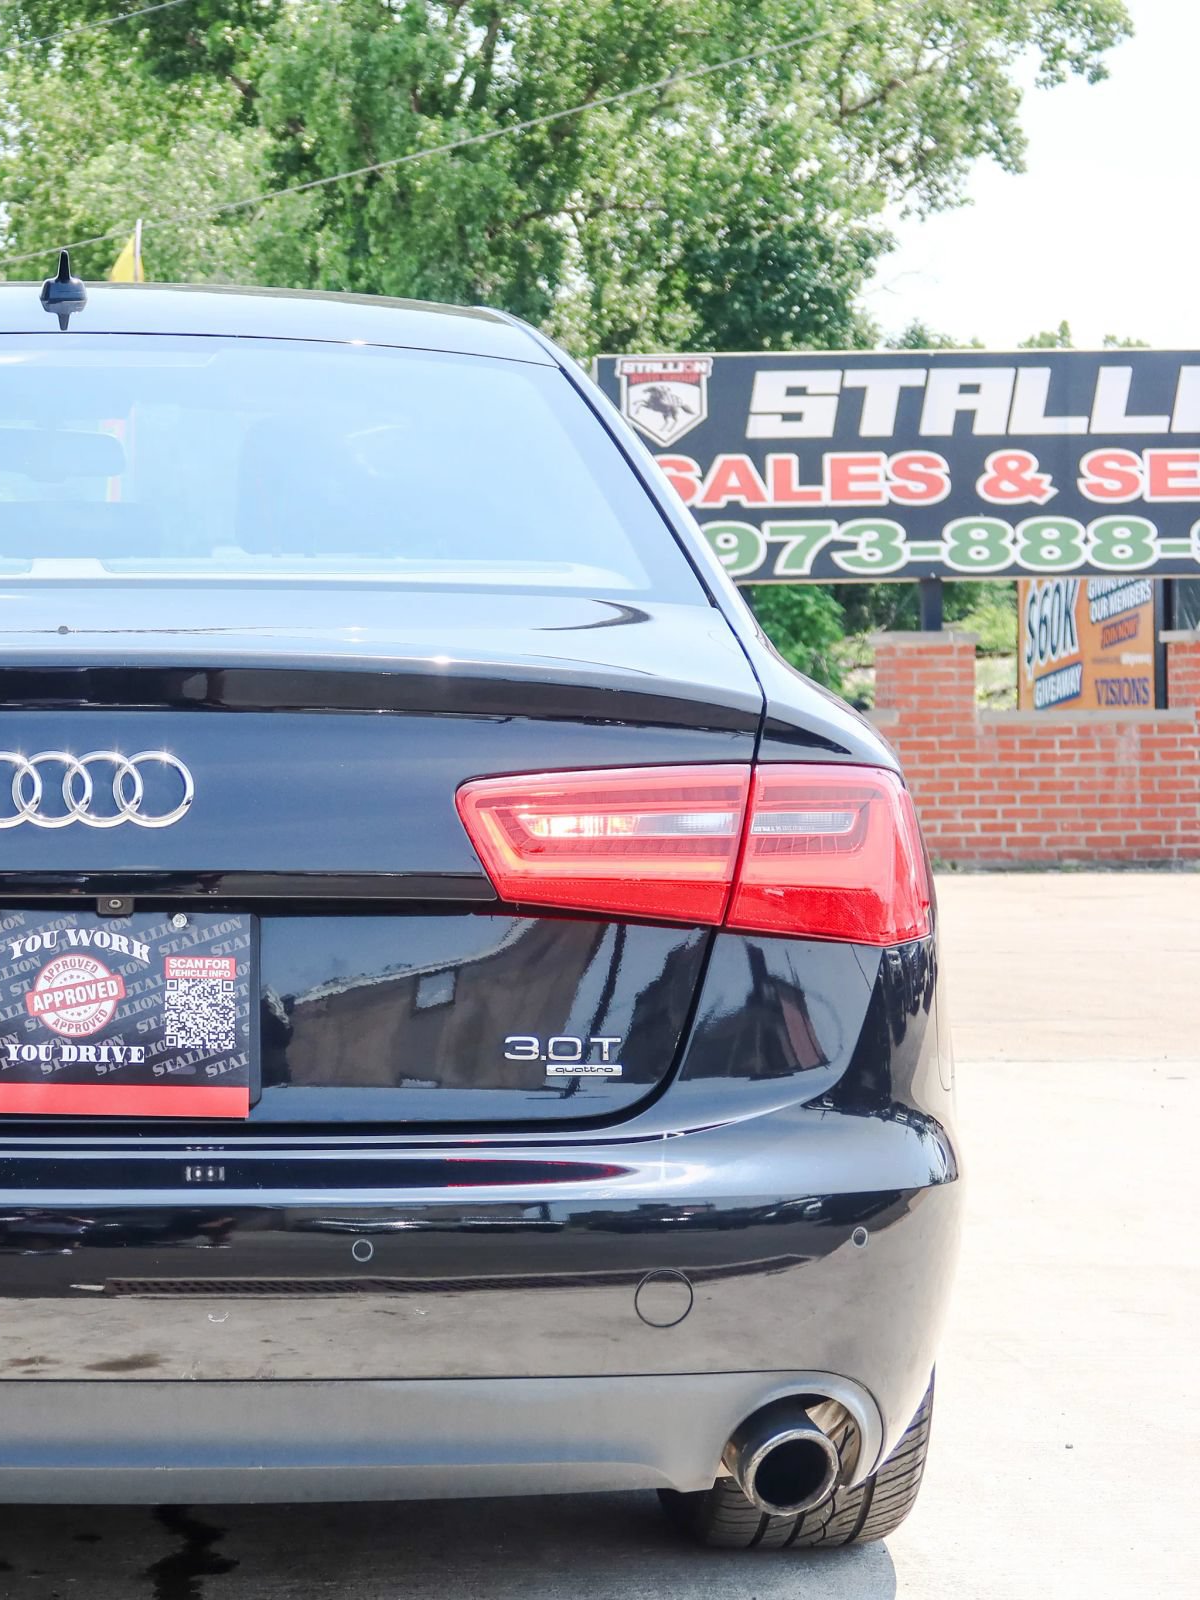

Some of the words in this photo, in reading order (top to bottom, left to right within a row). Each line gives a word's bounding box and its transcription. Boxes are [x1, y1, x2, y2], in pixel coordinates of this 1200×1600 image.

[656, 450, 951, 508] SALES
[976, 449, 1059, 505] &
[701, 514, 1200, 577] 973-888-
[1025, 577, 1081, 681] $60K
[1035, 663, 1082, 709] GIVEAWAY
[1095, 678, 1149, 705] VISIONS
[9, 929, 60, 960] YOU
[65, 928, 150, 963] WORK
[43, 958, 98, 983] APPROVED
[169, 958, 204, 969] SCAN
[205, 959, 230, 969] FOR
[169, 969, 208, 977] VEHICLE
[209, 970, 231, 978] INFO
[33, 980, 118, 1012] APPROVED
[52, 1009, 108, 1033] APPROVED
[5, 1044, 55, 1061] YOU
[59, 1045, 145, 1063] DRIVE
[504, 1036, 622, 1061] 3.0T
[555, 1066, 614, 1075] quattro
